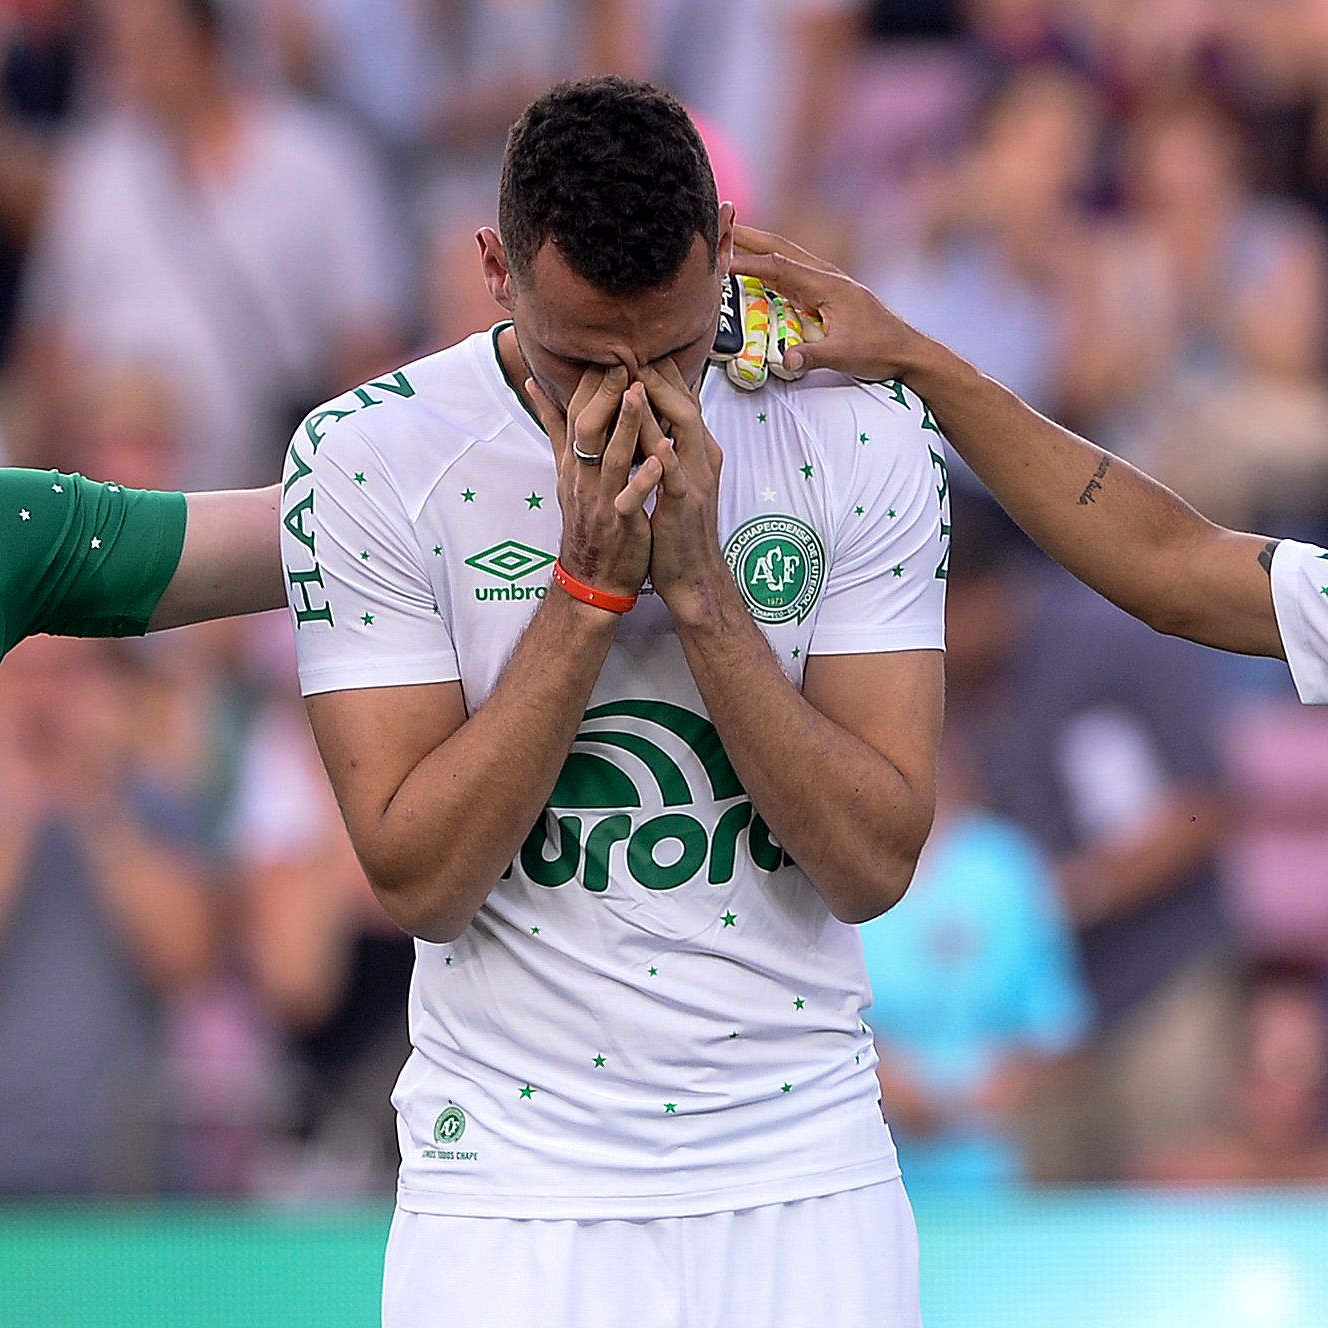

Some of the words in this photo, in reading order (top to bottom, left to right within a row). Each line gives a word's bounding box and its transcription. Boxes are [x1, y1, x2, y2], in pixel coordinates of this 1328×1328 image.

[283, 371, 417, 630] HAVAN
[738, 521, 812, 544] CHAPECOENSE
[501, 800, 796, 891] uror
[456, 1151, 478, 1161] CHAPE
